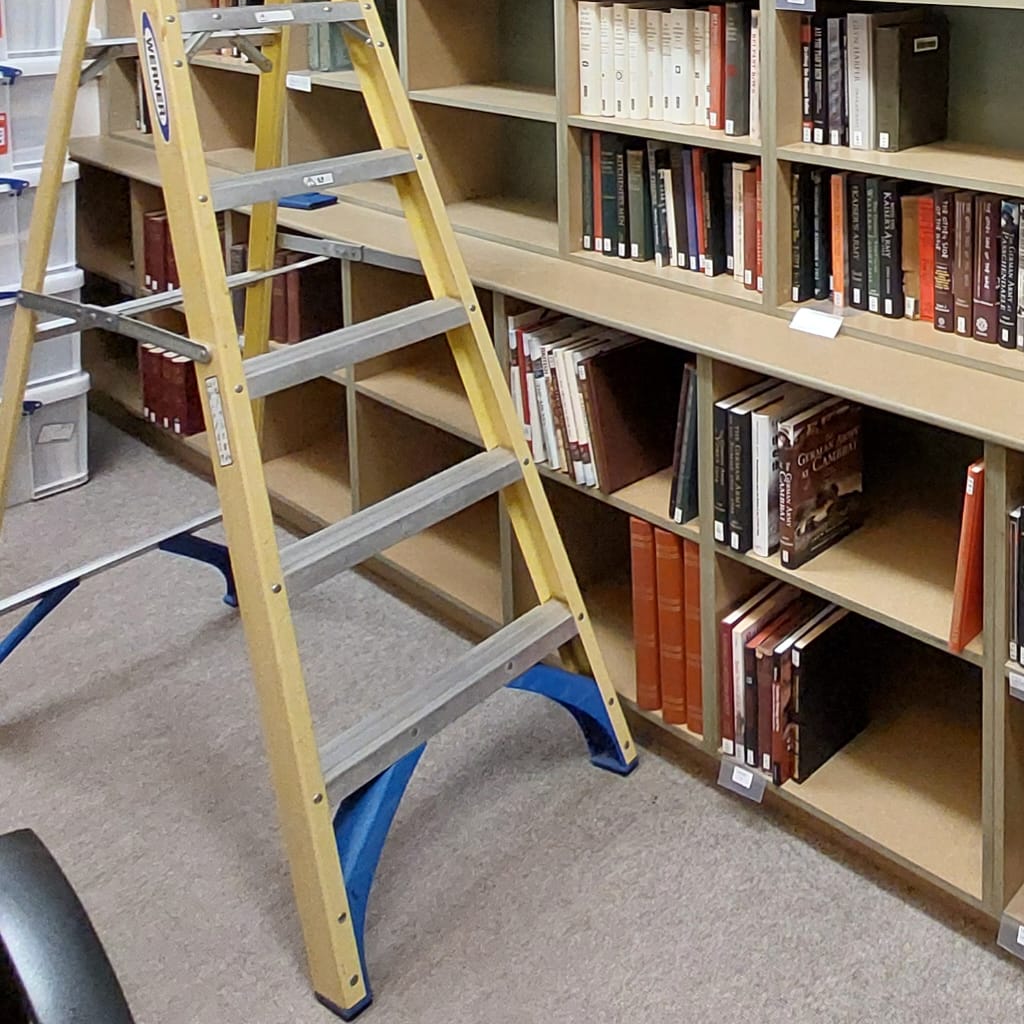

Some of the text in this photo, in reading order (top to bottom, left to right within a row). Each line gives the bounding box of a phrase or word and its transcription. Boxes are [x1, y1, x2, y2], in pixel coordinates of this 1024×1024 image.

[144, 37, 167, 116] WERNER
[853, 47, 861, 82] HARPER
[883, 191, 893, 258] KAISER'S ARMY
[852, 232, 860, 260] ARMY
[1007, 246, 1015, 279] GERMAN
[1000, 231, 1008, 311] PASSCHENDAELE
[1007, 280, 1015, 302] ARMY
[734, 444, 742, 481] GERMAN
[734, 482, 743, 510] ARMY
[777, 470, 787, 521] CAMBRAI
[784, 472, 793, 505] GERMAN
[785, 506, 793, 528] ARMY
